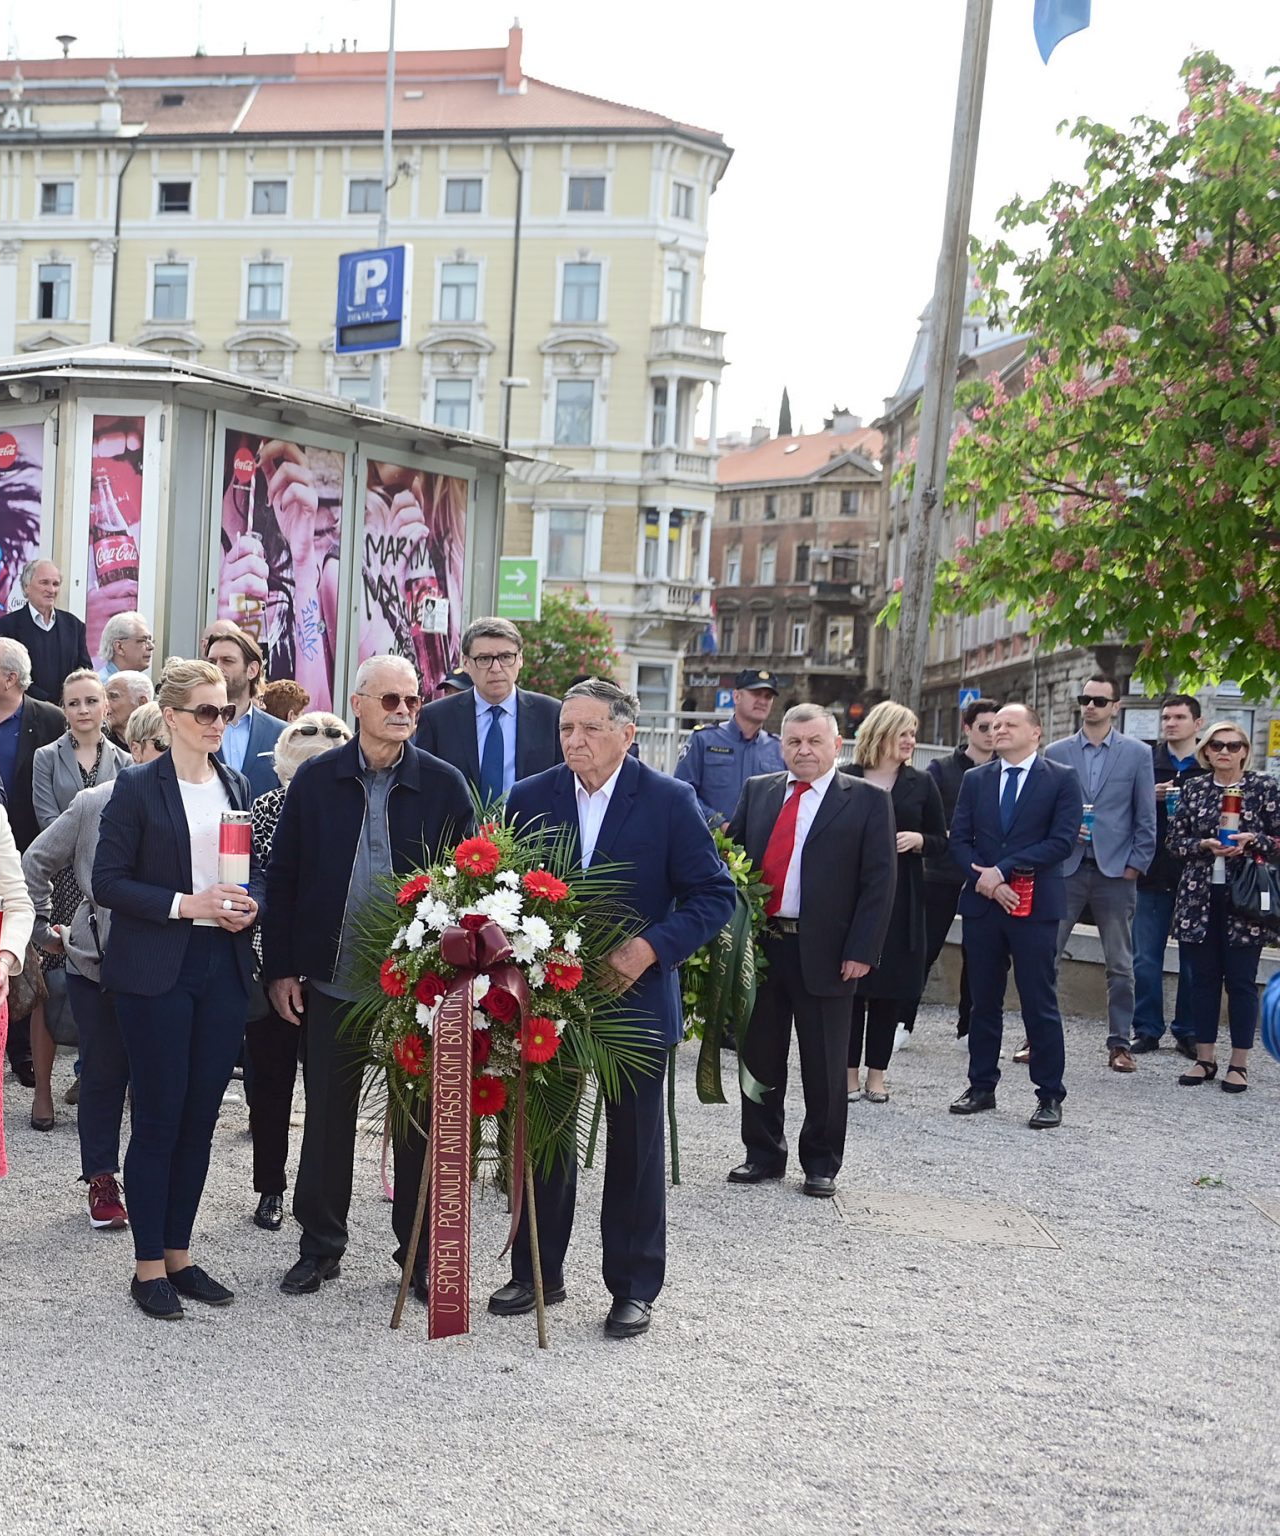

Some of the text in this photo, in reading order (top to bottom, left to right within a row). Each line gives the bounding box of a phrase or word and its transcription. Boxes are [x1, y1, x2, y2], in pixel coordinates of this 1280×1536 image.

[353, 258, 388, 306] P
[96, 542, 138, 569] Coca-Cola
[719, 691, 731, 707] P
[435, 989, 464, 1313] U SPOMEN POGINULIM ANTIFAŠISTIČKIM BORCIMA
